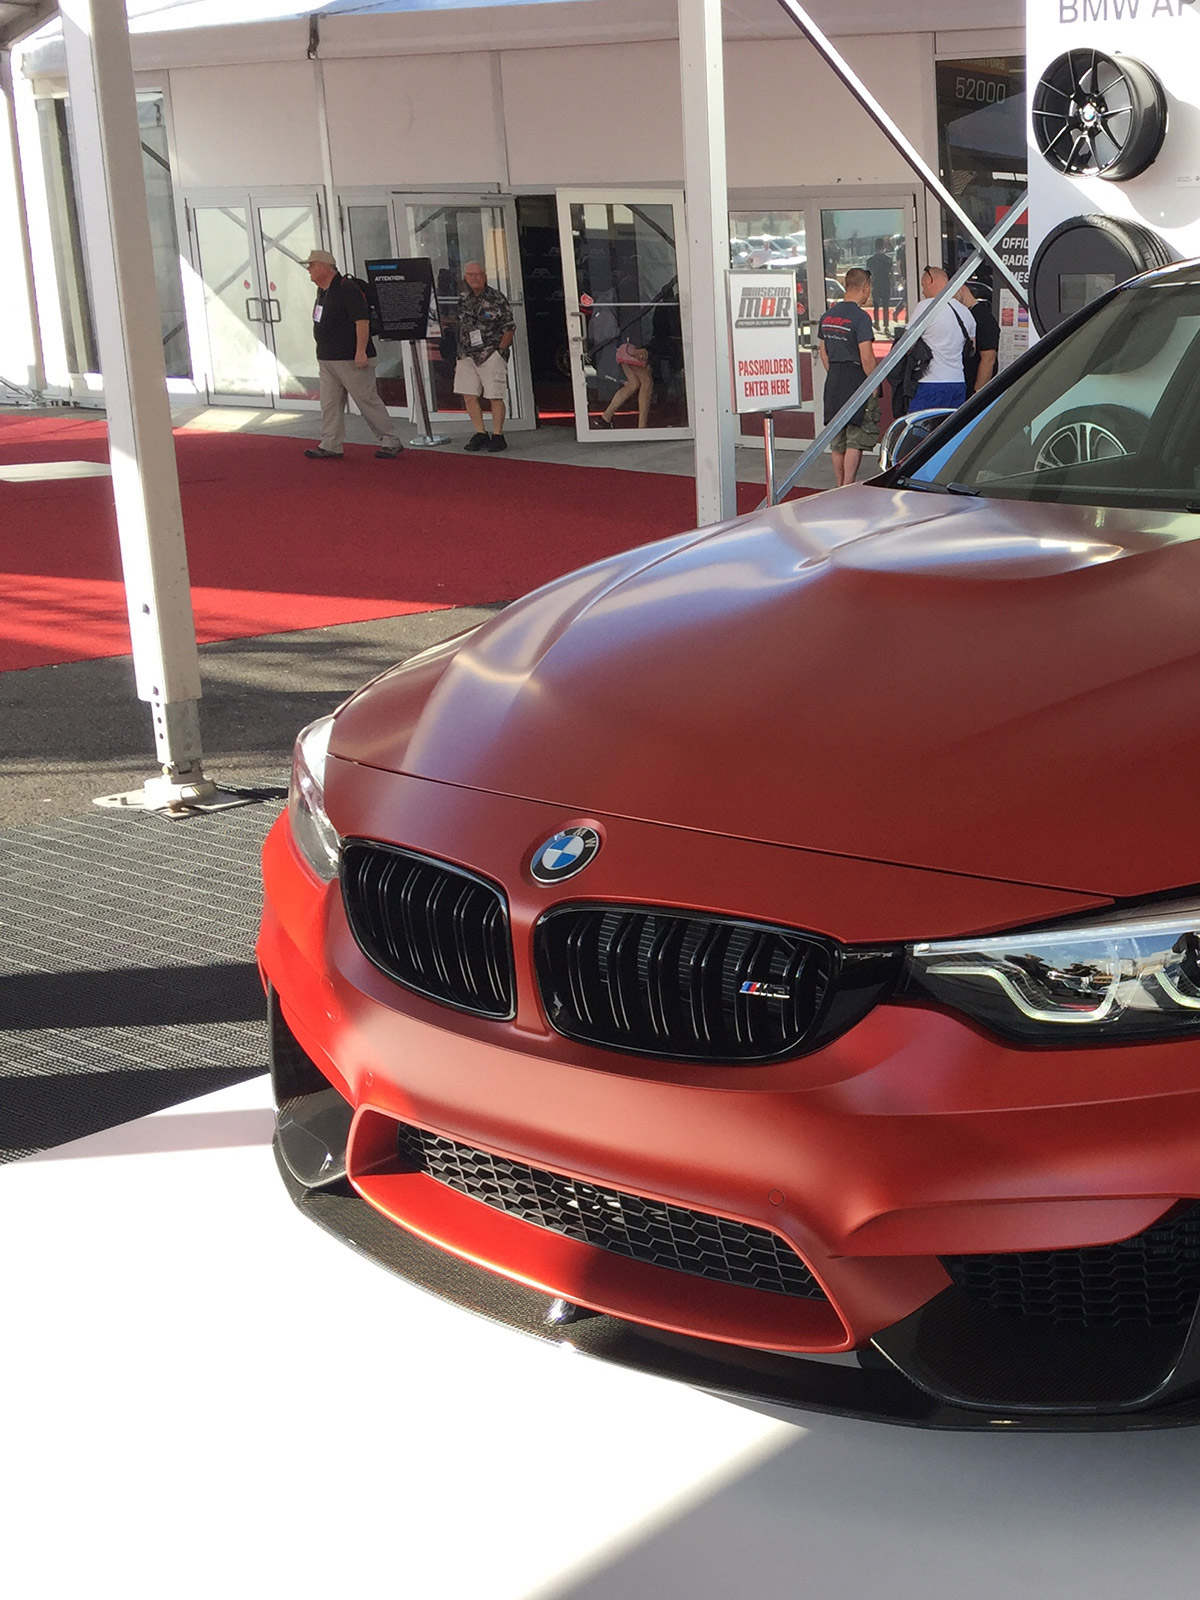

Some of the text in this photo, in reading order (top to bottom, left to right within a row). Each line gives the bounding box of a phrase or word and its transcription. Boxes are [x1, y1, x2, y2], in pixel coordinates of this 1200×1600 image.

[1060, 0, 1139, 23] BMW
[955, 76, 1006, 104] 52000
[760, 286, 791, 297] SEMA
[738, 297, 791, 318] MBR
[738, 358, 794, 377] PASSHOLDERS
[744, 379, 791, 398] ENTER HERE
